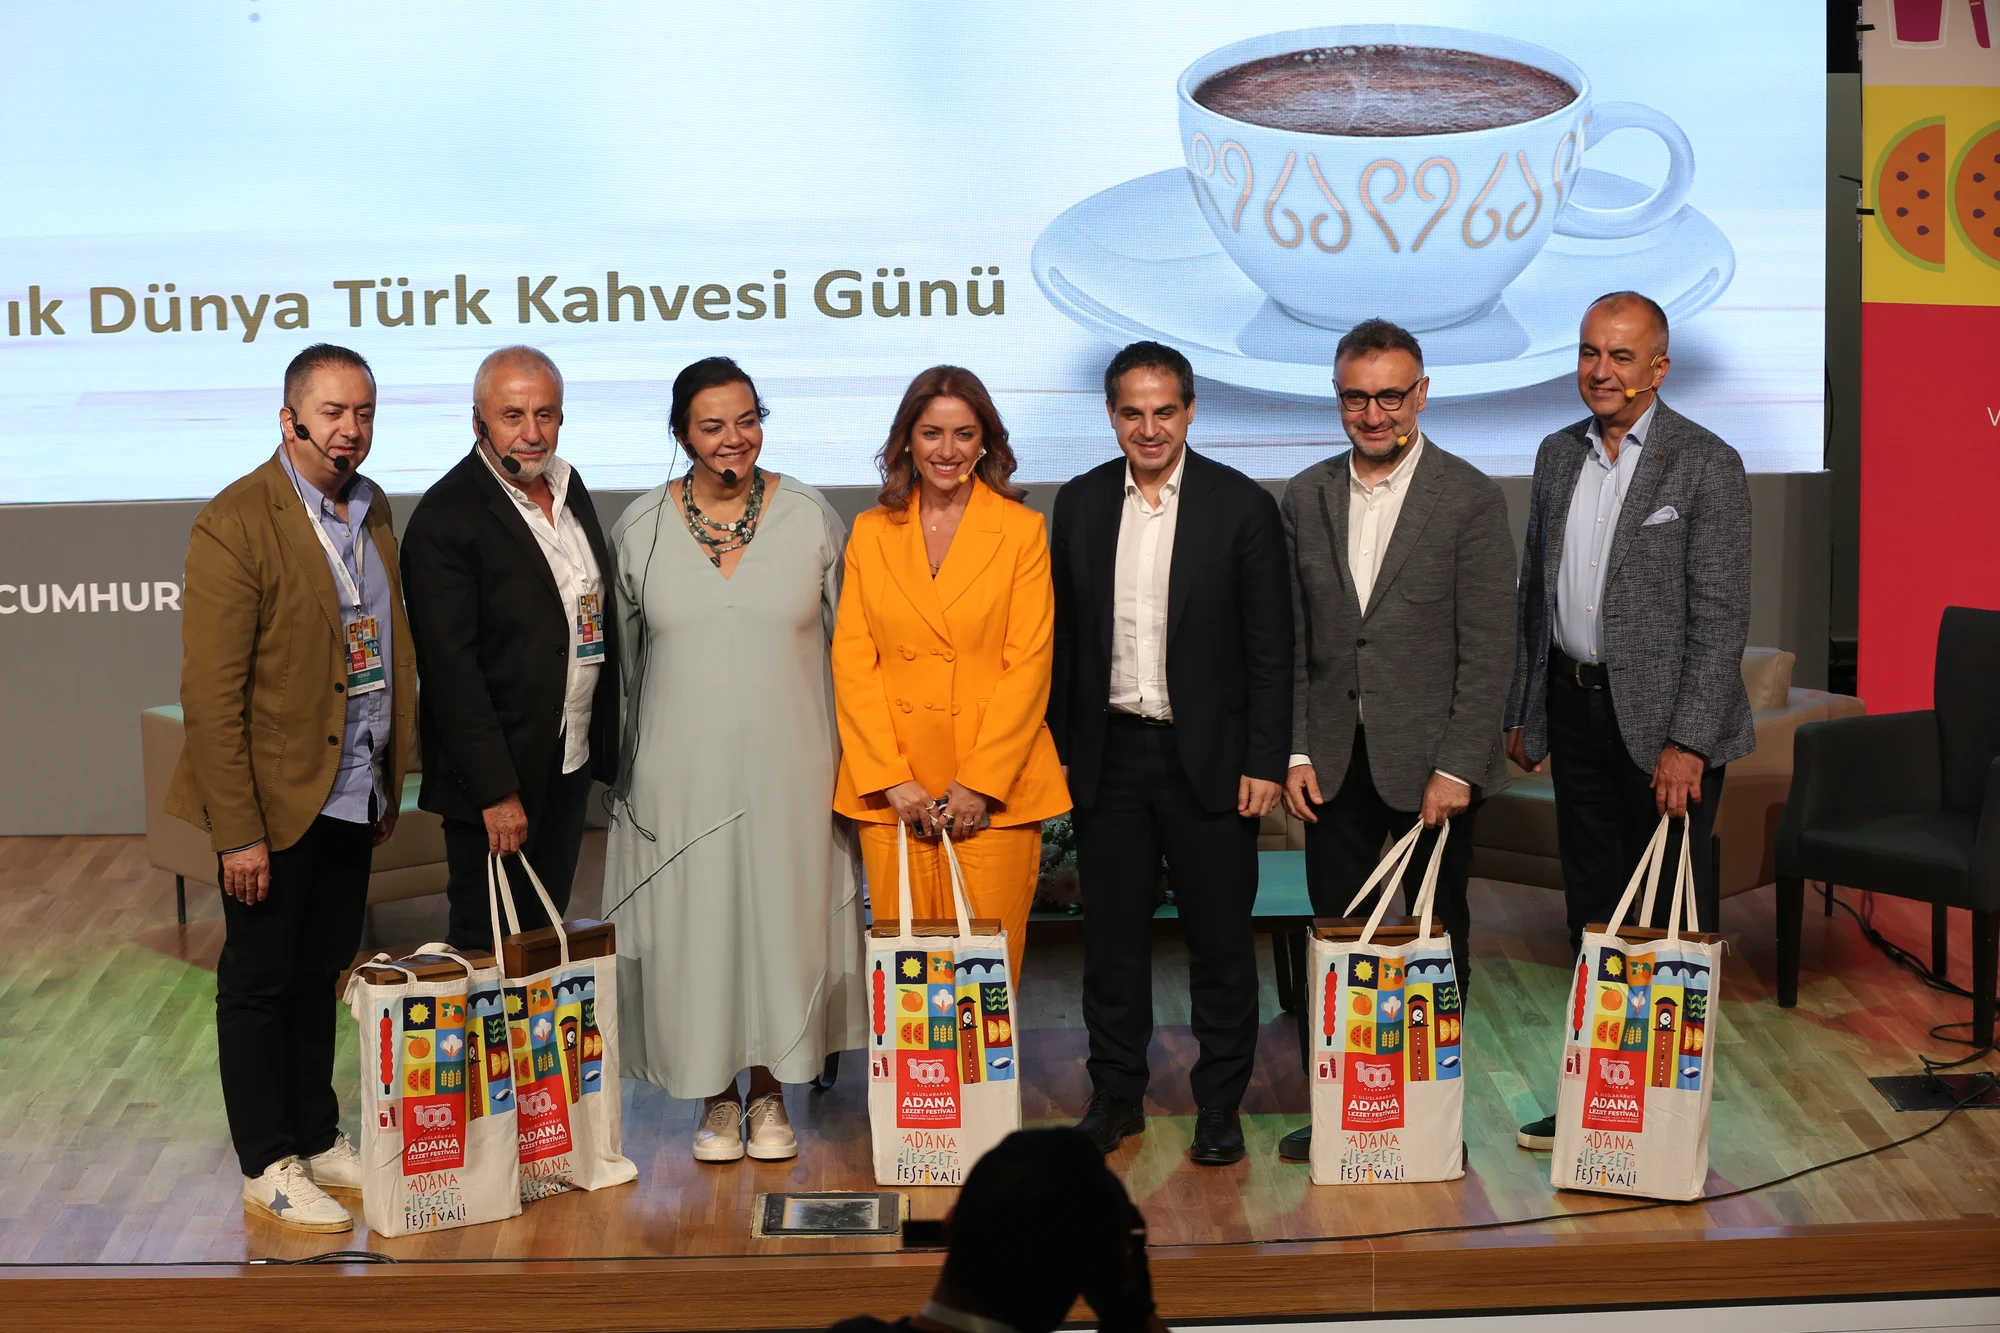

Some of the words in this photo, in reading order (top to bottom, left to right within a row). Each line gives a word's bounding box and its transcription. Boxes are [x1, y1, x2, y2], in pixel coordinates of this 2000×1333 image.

[8, 285, 65, 336] ık
[90, 283, 309, 343] Dünya
[333, 274, 493, 328] Türk
[517, 269, 786, 324] Kahvesi
[814, 266, 1004, 319] Günü
[0, 580, 185, 614] CUMHUR
[902, 1096, 955, 1108] ADANA
[1348, 1098, 1399, 1111] ADANA
[1590, 1097, 1639, 1111] ADANA
[518, 1123, 566, 1144] ADANA
[904, 1131, 956, 1149] ADANA
[1348, 1132, 1399, 1149] ADANA
[1586, 1131, 1634, 1150] ADANA
[407, 1138, 460, 1154] ADANA
[905, 1148, 952, 1168] LEZZET
[1349, 1149, 1395, 1165] LEZZET
[1584, 1148, 1628, 1170] LEZZET
[522, 1157, 571, 1179] ADANA
[410, 1172, 458, 1193] ADANA
[413, 1190, 455, 1212] LEZZET
